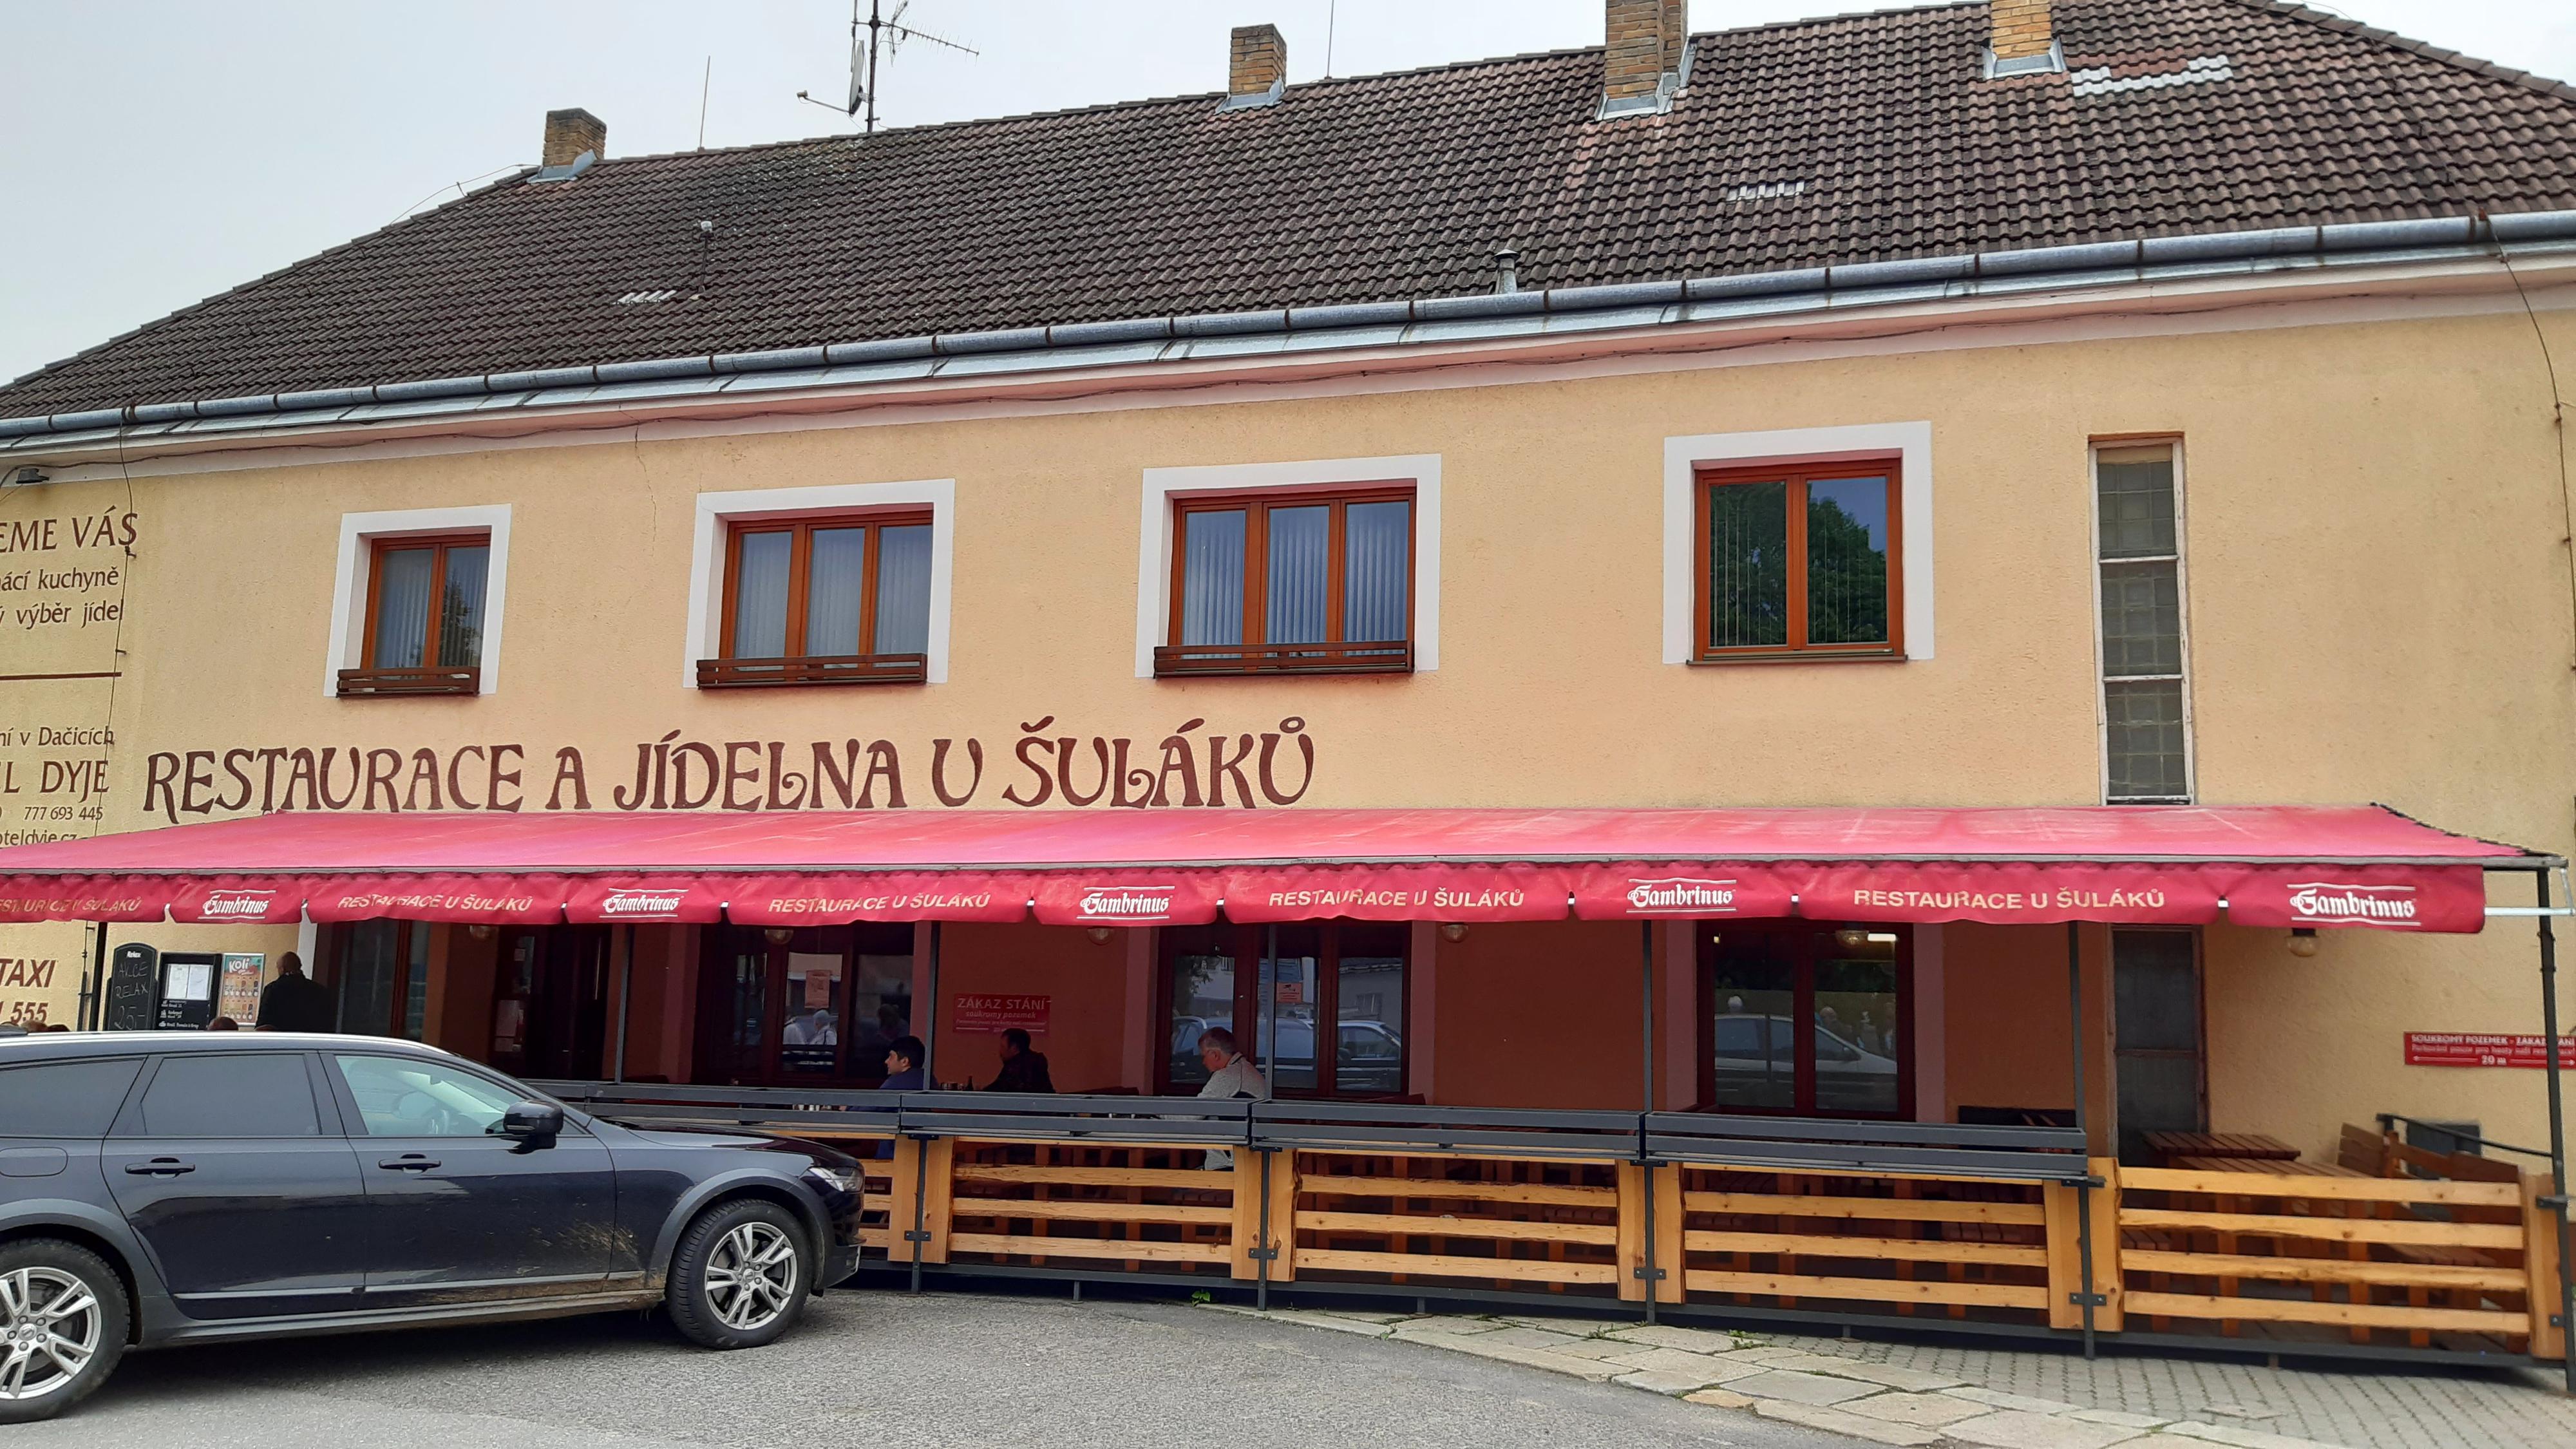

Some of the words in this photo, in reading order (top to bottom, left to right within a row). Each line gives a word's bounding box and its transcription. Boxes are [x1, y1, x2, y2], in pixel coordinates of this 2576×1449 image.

[71, 505, 138, 548] VÁS
[37, 566, 119, 592] kuchyně
[16, 602, 71, 630] výběr
[81, 600, 124, 629] jídel
[19, 732, 31, 746] v
[38, 726, 114, 746] Dačicích
[143, 744, 524, 824] RESTAURACE
[545, 746, 591, 810] A
[613, 729, 907, 811] JÍDELNA
[932, 737, 983, 807] U
[1001, 715, 1314, 809] ŠULÁKŮ
[40, 761, 109, 803] DYJE
[24, 806, 47, 820] 777
[50, 806, 73, 820] 693
[78, 806, 103, 820] 445
[202, 894, 269, 914] Gambrinus
[444, 896, 458, 909] U
[603, 893, 681, 913] Gambrinus
[768, 896, 889, 913] RESTAURACE
[892, 896, 905, 908] U
[909, 891, 991, 909] ŠULÁKŮ
[1079, 892, 1170, 914] Gambrinus
[1269, 888, 1408, 907] RESTAURACE
[1414, 889, 1428, 906] U
[1434, 887, 1524, 907] ŠULÁKŮ
[1627, 884, 1734, 907] Gambrinus
[1853, 890, 2023, 909] RESTAURACE
[2031, 893, 2048, 909] U
[2056, 887, 2164, 909] ŠULÁKŮ
[2289, 888, 2416, 918] Gambrinus
[0, 958, 56, 988] TAXI
[115, 982, 149, 999] RELAX
[10, 1001, 48, 1024] 555
[958, 996, 1001, 1009] ZÁKAZ
[1007, 997, 1046, 1010] STÁNÍ
